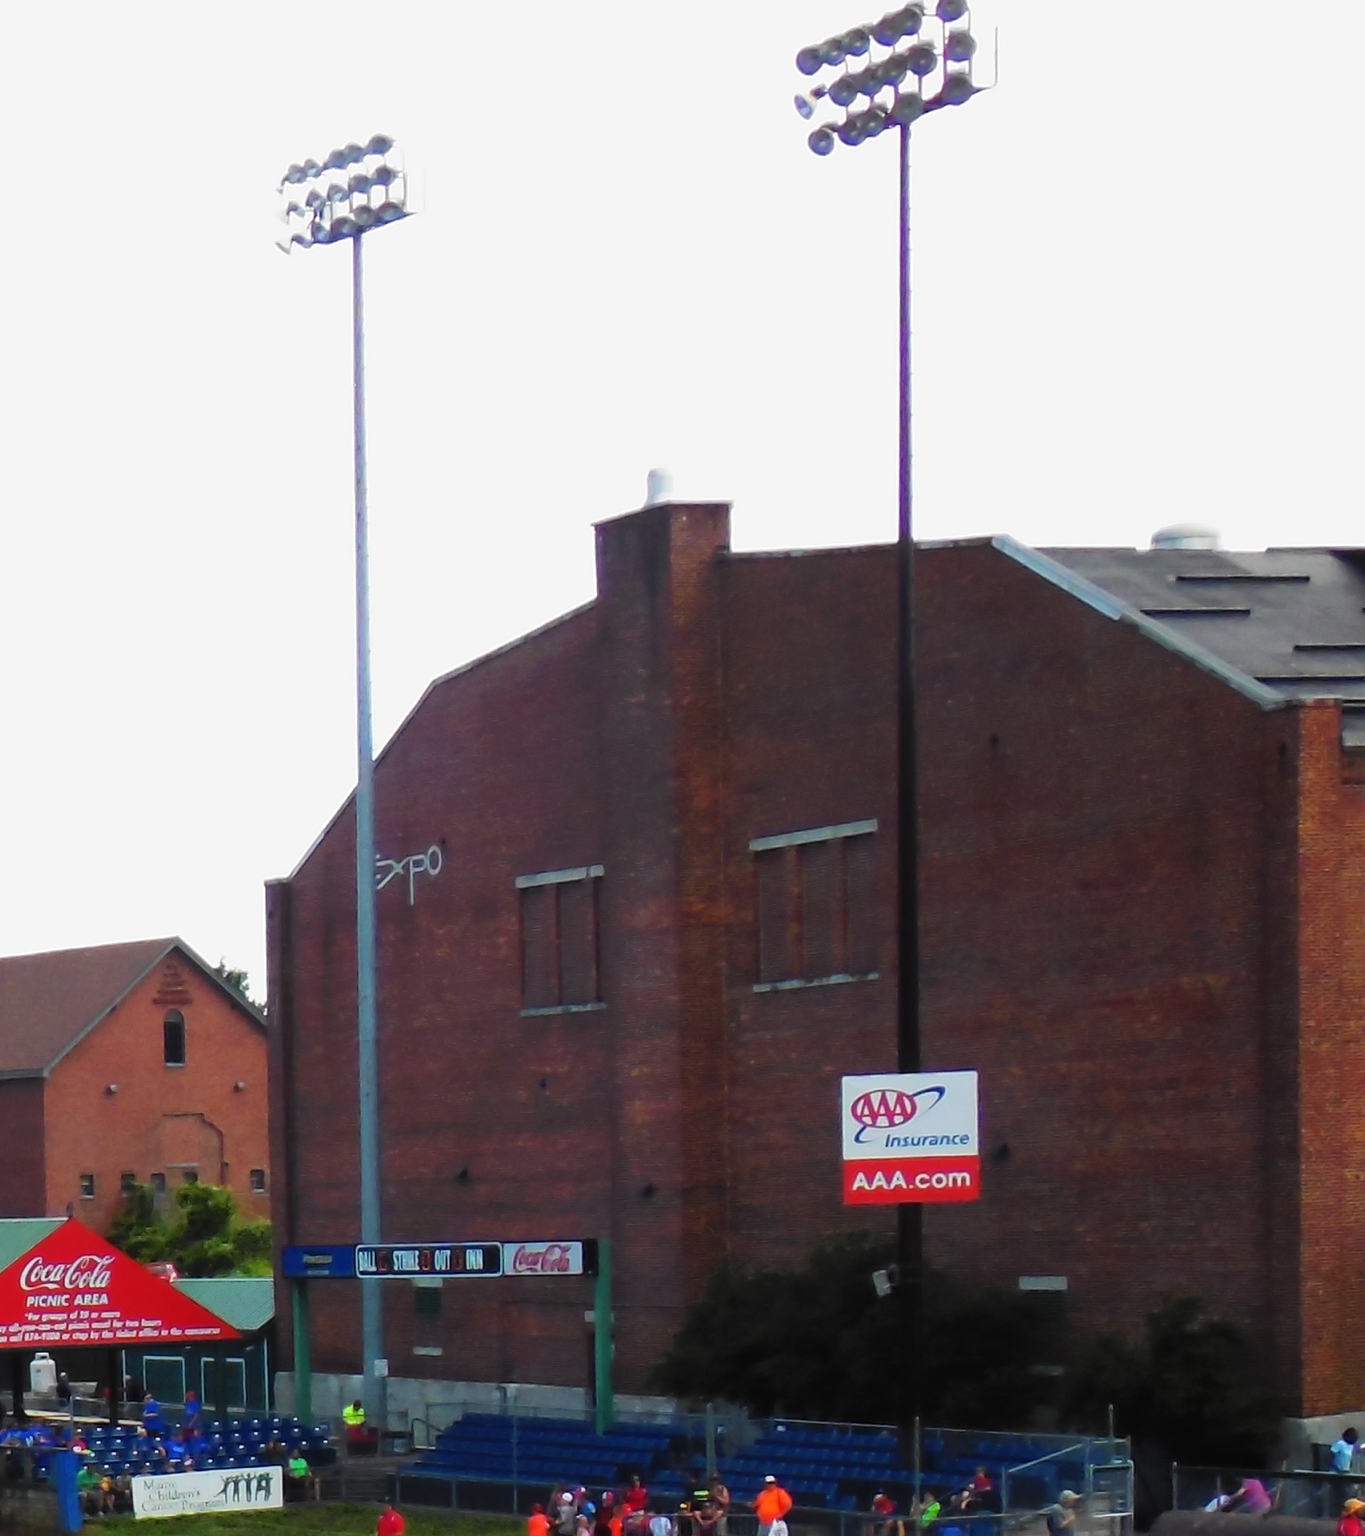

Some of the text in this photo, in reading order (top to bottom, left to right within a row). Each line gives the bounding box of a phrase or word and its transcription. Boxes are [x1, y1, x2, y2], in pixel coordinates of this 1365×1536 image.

[854, 1089, 914, 1128] AAA
[885, 1133, 970, 1148] Insurance
[852, 1170, 971, 1191] AAA.com
[26, 1293, 109, 1308] PICNIC AREA
[148, 1488, 201, 1501] Children's
